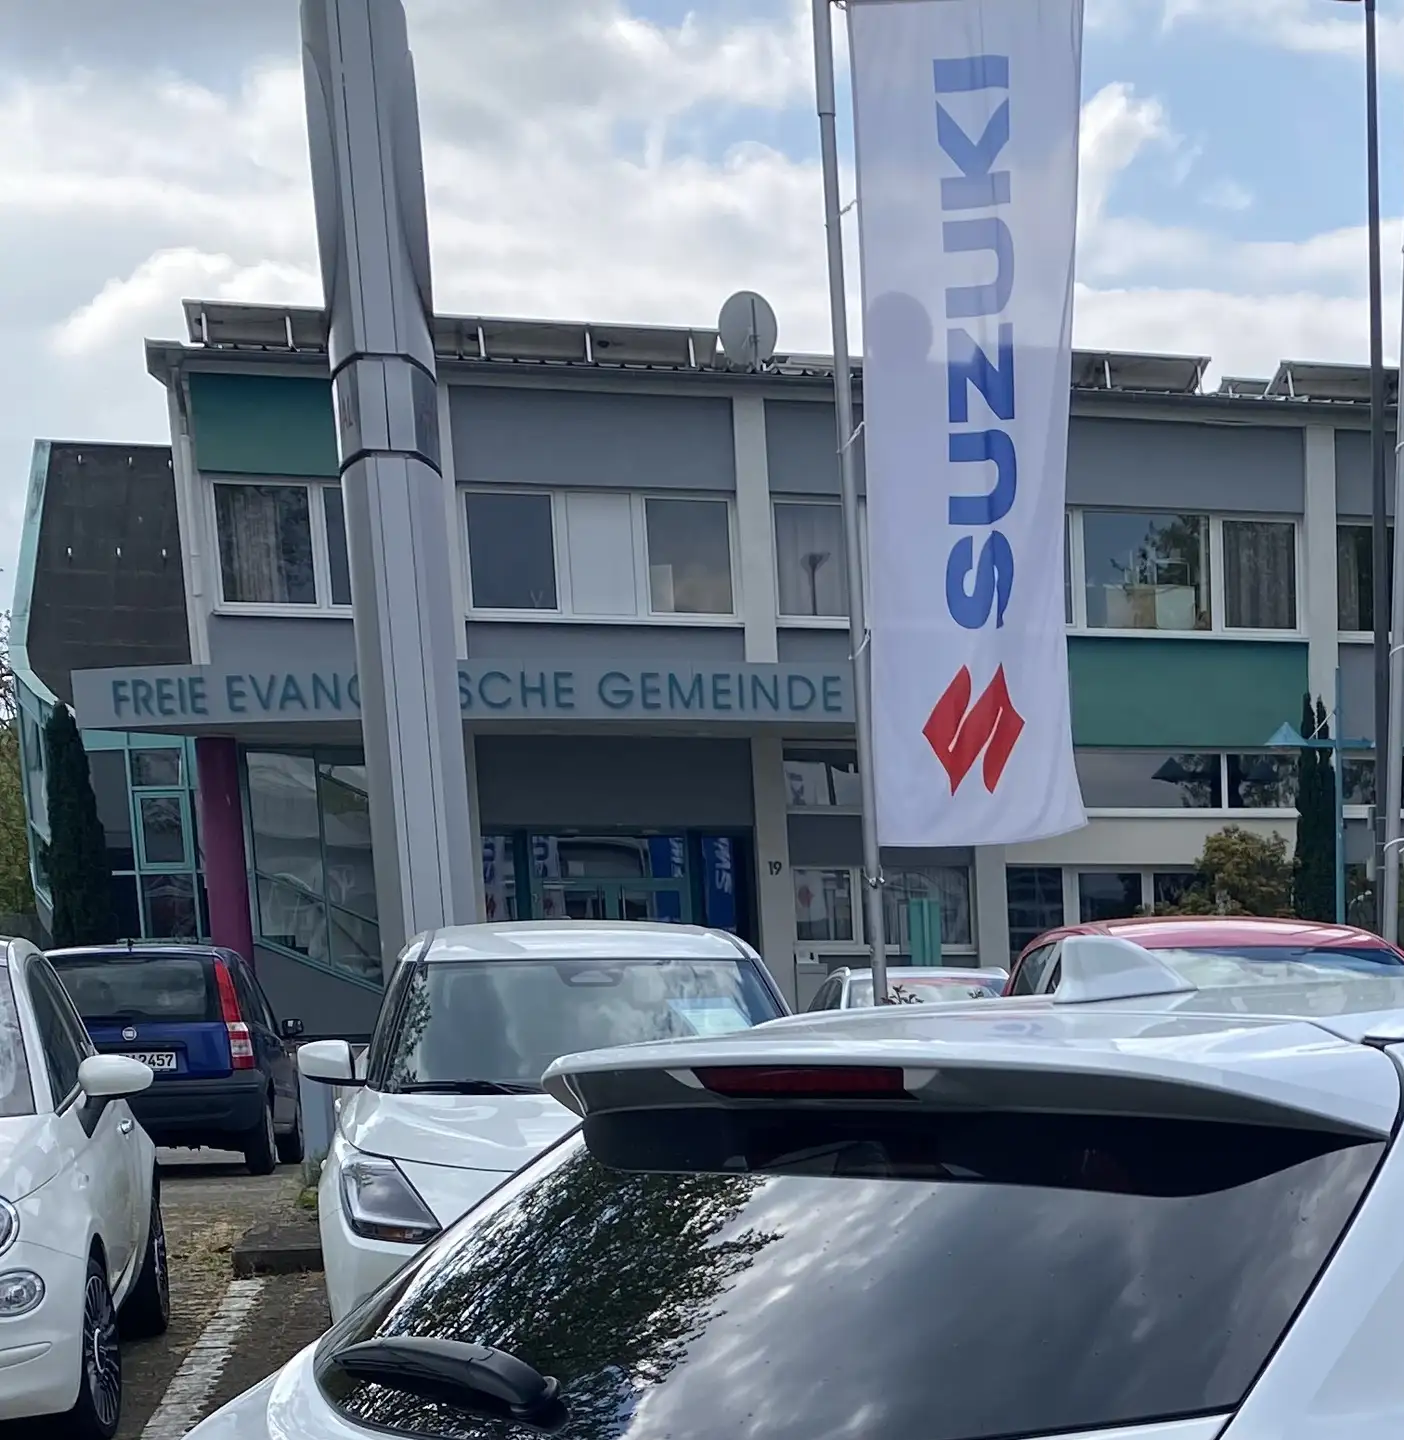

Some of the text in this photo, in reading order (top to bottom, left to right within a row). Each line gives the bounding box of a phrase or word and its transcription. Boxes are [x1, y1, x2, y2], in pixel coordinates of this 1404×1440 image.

[933, 55, 1016, 629] SUZUKI
[112, 677, 209, 718] FREIE
[598, 671, 842, 711] GEMEINDE
[768, 861, 783, 876] 19
